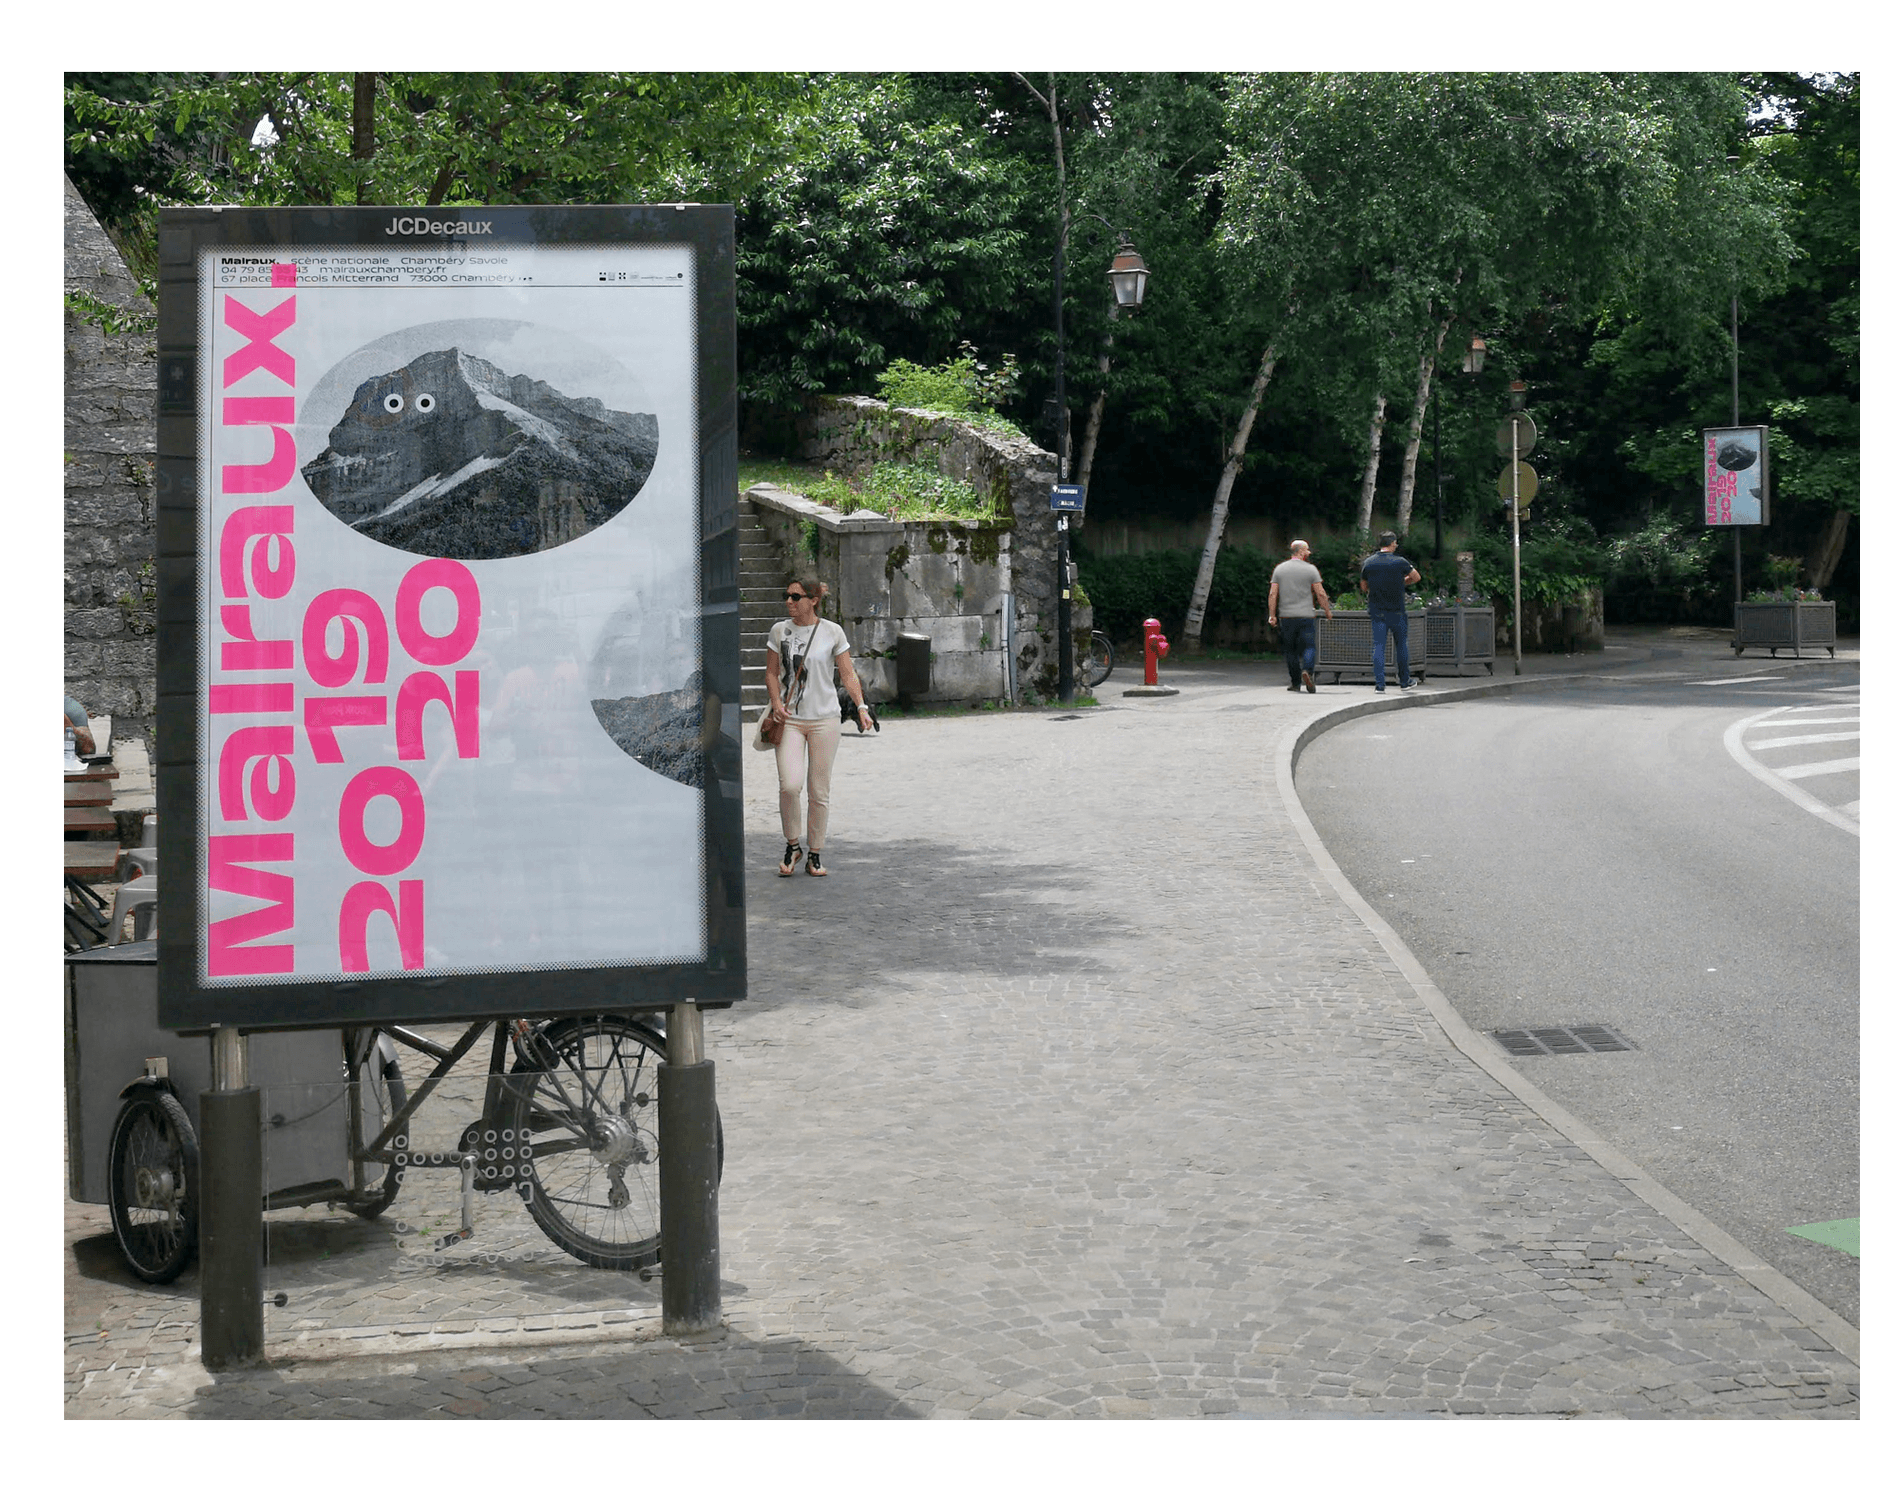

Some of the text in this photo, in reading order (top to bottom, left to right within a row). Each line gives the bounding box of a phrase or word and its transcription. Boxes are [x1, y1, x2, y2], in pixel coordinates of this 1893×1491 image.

[385, 217, 493, 235] JCDecaux
[221, 255, 508, 266] Malraux. scène nationale Chambéry Savoie
[221, 266, 237, 274] 04
[240, 266, 255, 274] 79
[258, 266, 272, 274] 85
[319, 265, 447, 275] malrauxchambery.fr
[221, 275, 236, 283] 67
[239, 275, 272, 284] place
[332, 274, 399, 283] Mitterrand
[410, 274, 448, 283] 73000
[396, 557, 481, 760] 20
[302, 589, 389, 764] 19
[339, 766, 425, 974] 20
